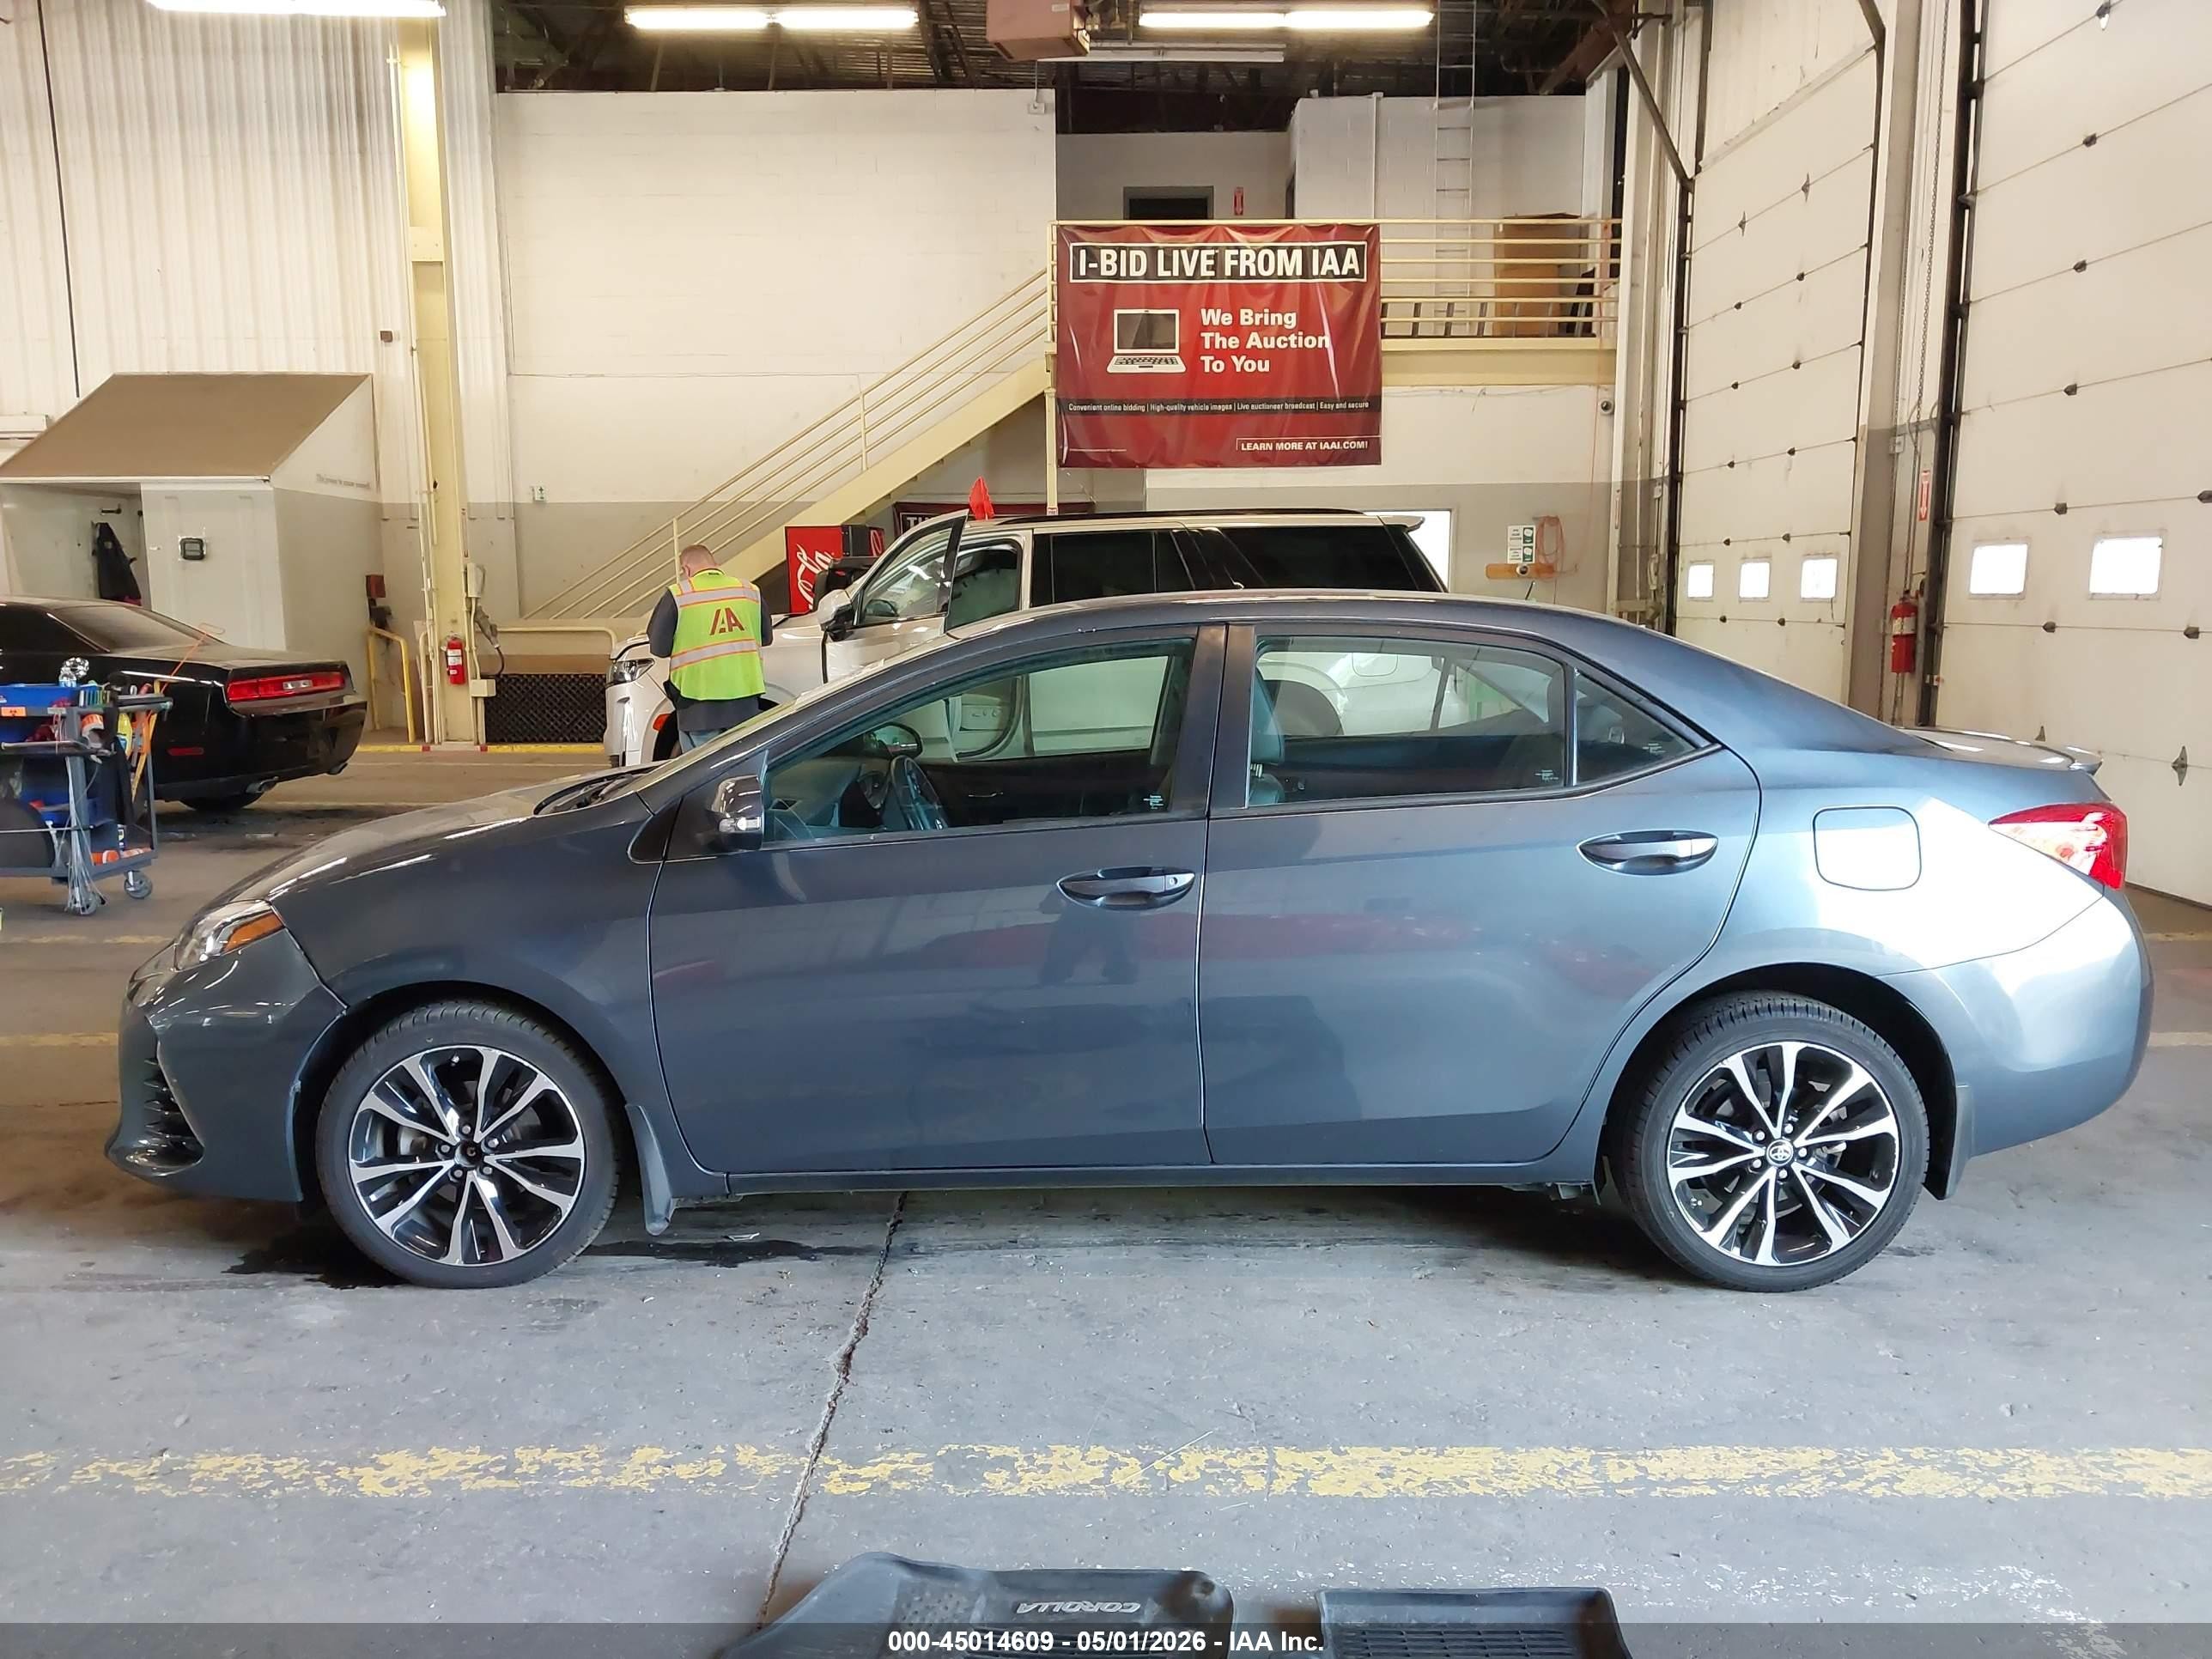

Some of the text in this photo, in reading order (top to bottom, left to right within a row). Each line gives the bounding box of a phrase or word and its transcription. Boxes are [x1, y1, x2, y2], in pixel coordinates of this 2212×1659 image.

[1079, 247, 1360, 277] I-BID LIVE FROM IAA
[1200, 308, 1297, 329] We Bring
[1200, 331, 1330, 349] The Auction
[1200, 355, 1270, 373] To You
[1068, 404, 1103, 412] Convenient
[1122, 404, 1146, 414] bidding
[1150, 404, 1187, 413] High-quality
[1187, 404, 1209, 412] vehicle
[1210, 404, 1233, 412] images
[1285, 402, 1316, 410] broadcast
[1320, 401, 1334, 410] Easy
[1335, 401, 1347, 410] and
[1241, 442, 1273, 451] LEARN
[1275, 442, 1303, 451] MORE
[1305, 441, 1317, 450] AT
[1017, 1601, 1140, 1614] COROLLA
